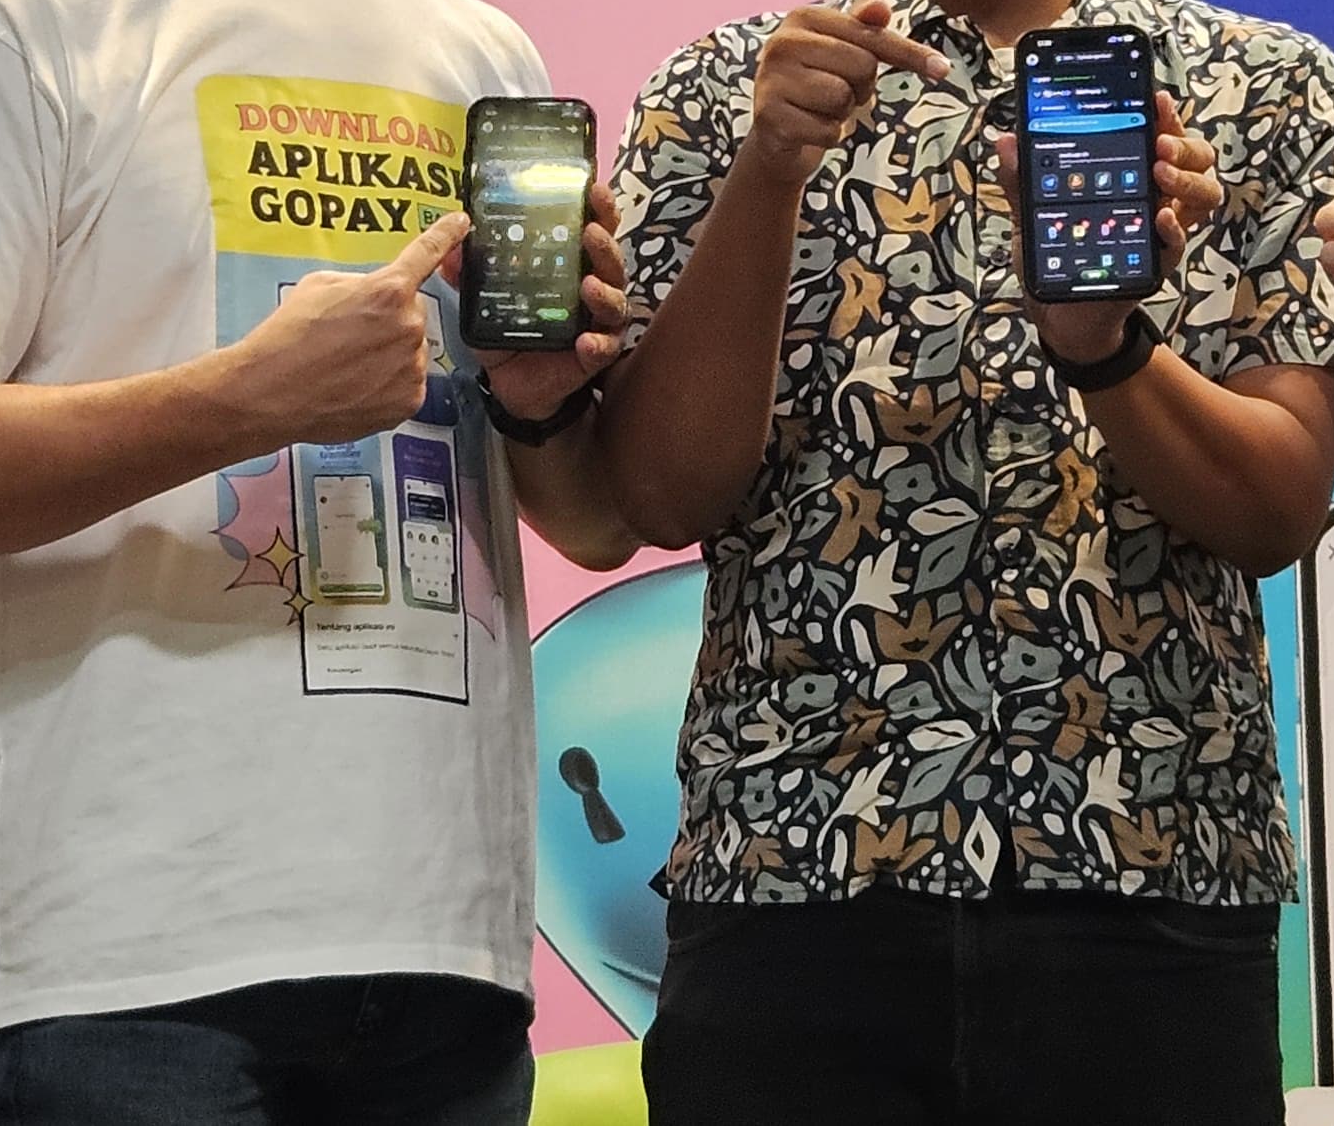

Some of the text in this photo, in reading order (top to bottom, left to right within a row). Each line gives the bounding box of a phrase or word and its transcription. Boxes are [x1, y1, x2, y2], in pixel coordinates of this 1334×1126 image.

[235, 103, 457, 158] DOWNLOAD
[248, 140, 465, 201] APLIKASI
[251, 186, 412, 233] GOPAY
